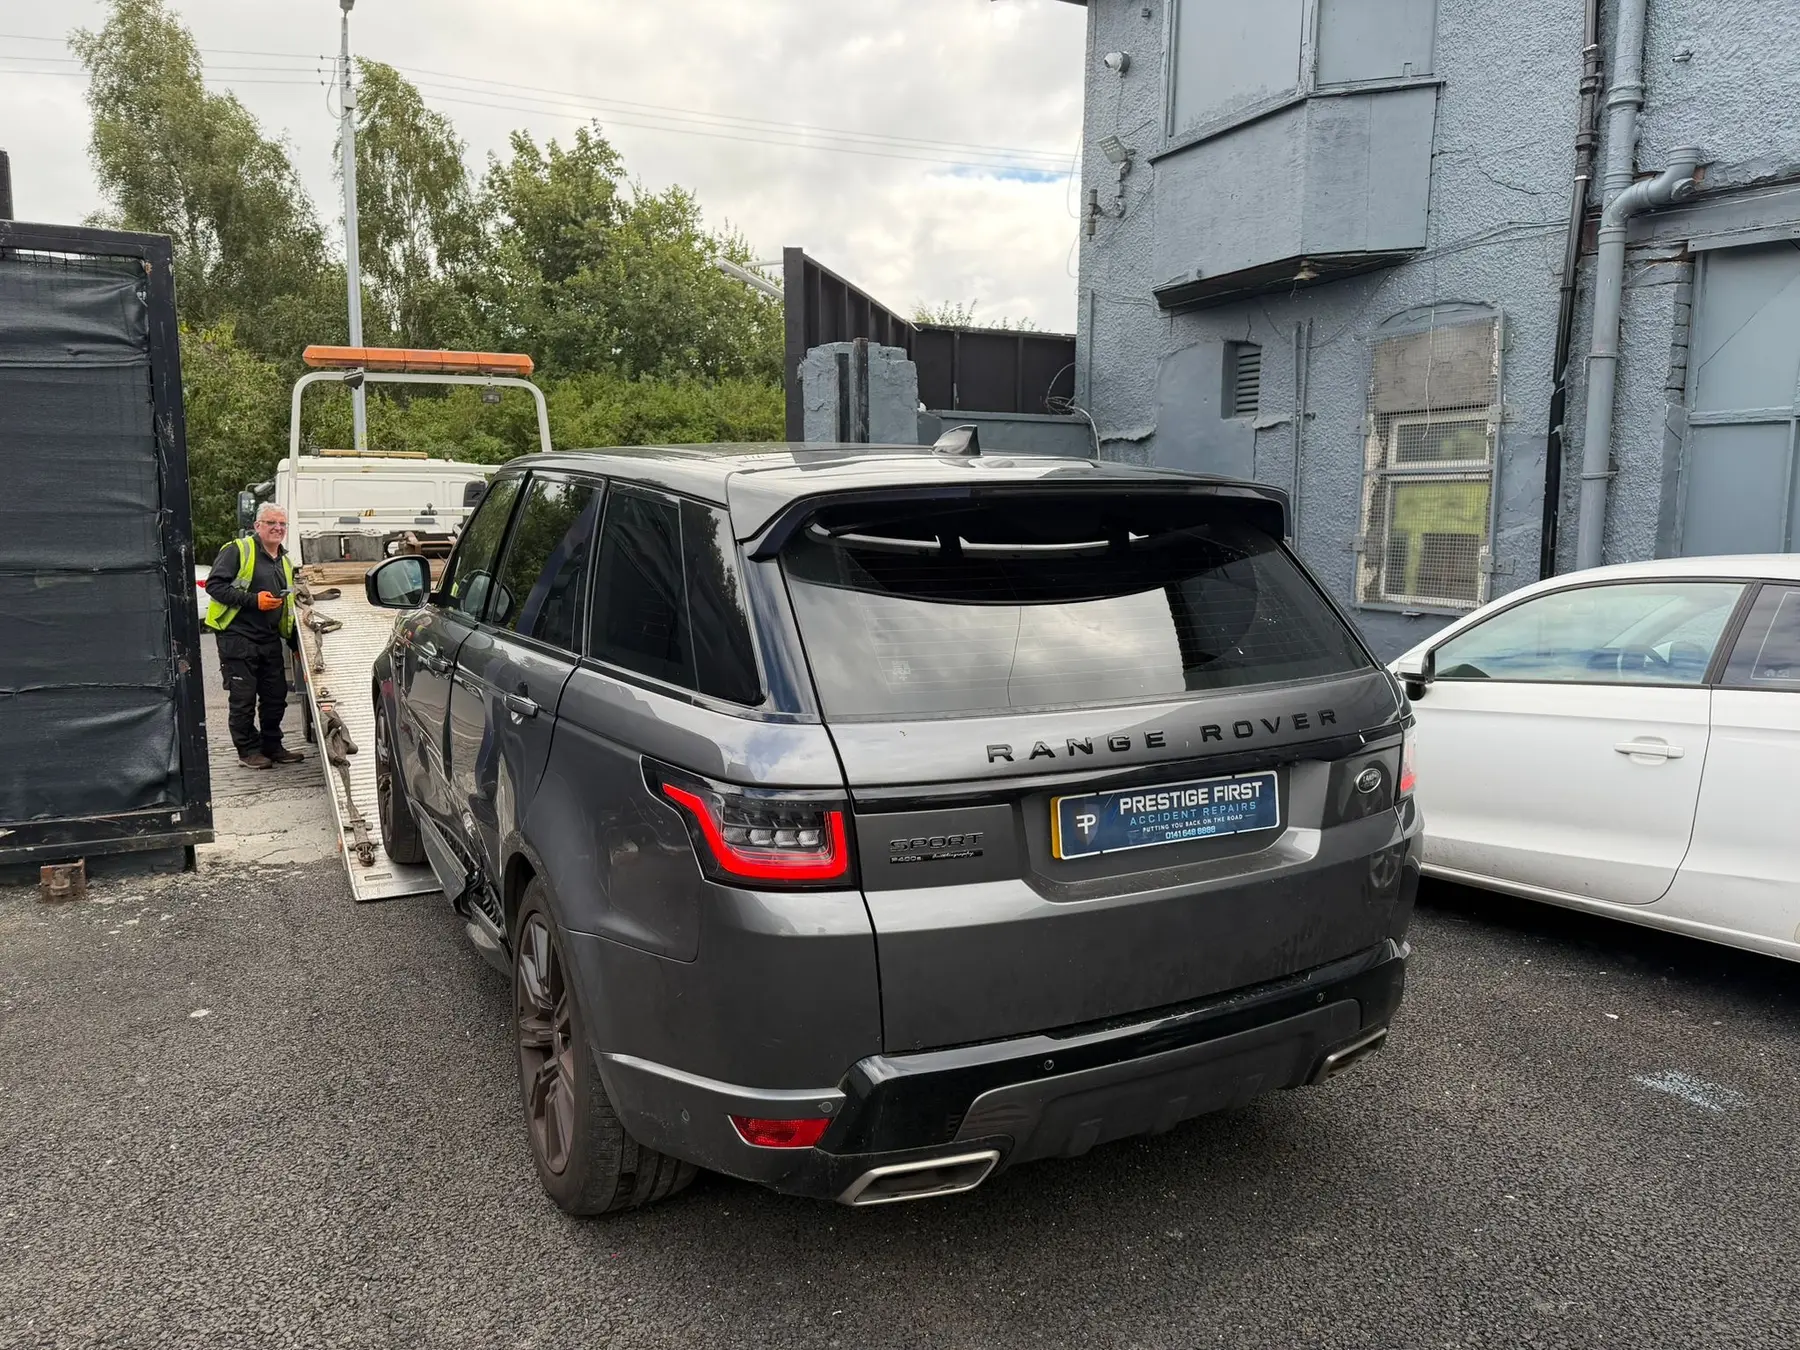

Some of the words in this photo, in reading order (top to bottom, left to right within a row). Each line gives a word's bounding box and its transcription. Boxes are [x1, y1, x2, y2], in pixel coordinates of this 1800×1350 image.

[986, 730, 1166, 763] RANGE
[1199, 709, 1338, 742] ROVER
[1119, 790, 1210, 815] PRESTIGE
[1214, 781, 1263, 803] FIRST
[1129, 809, 1197, 826] ACCIDENT
[1203, 801, 1257, 816] REPAIRS
[1142, 824, 1170, 833] PUTTING
[1165, 830, 1182, 840] 0141
[889, 832, 984, 852] SPORT
